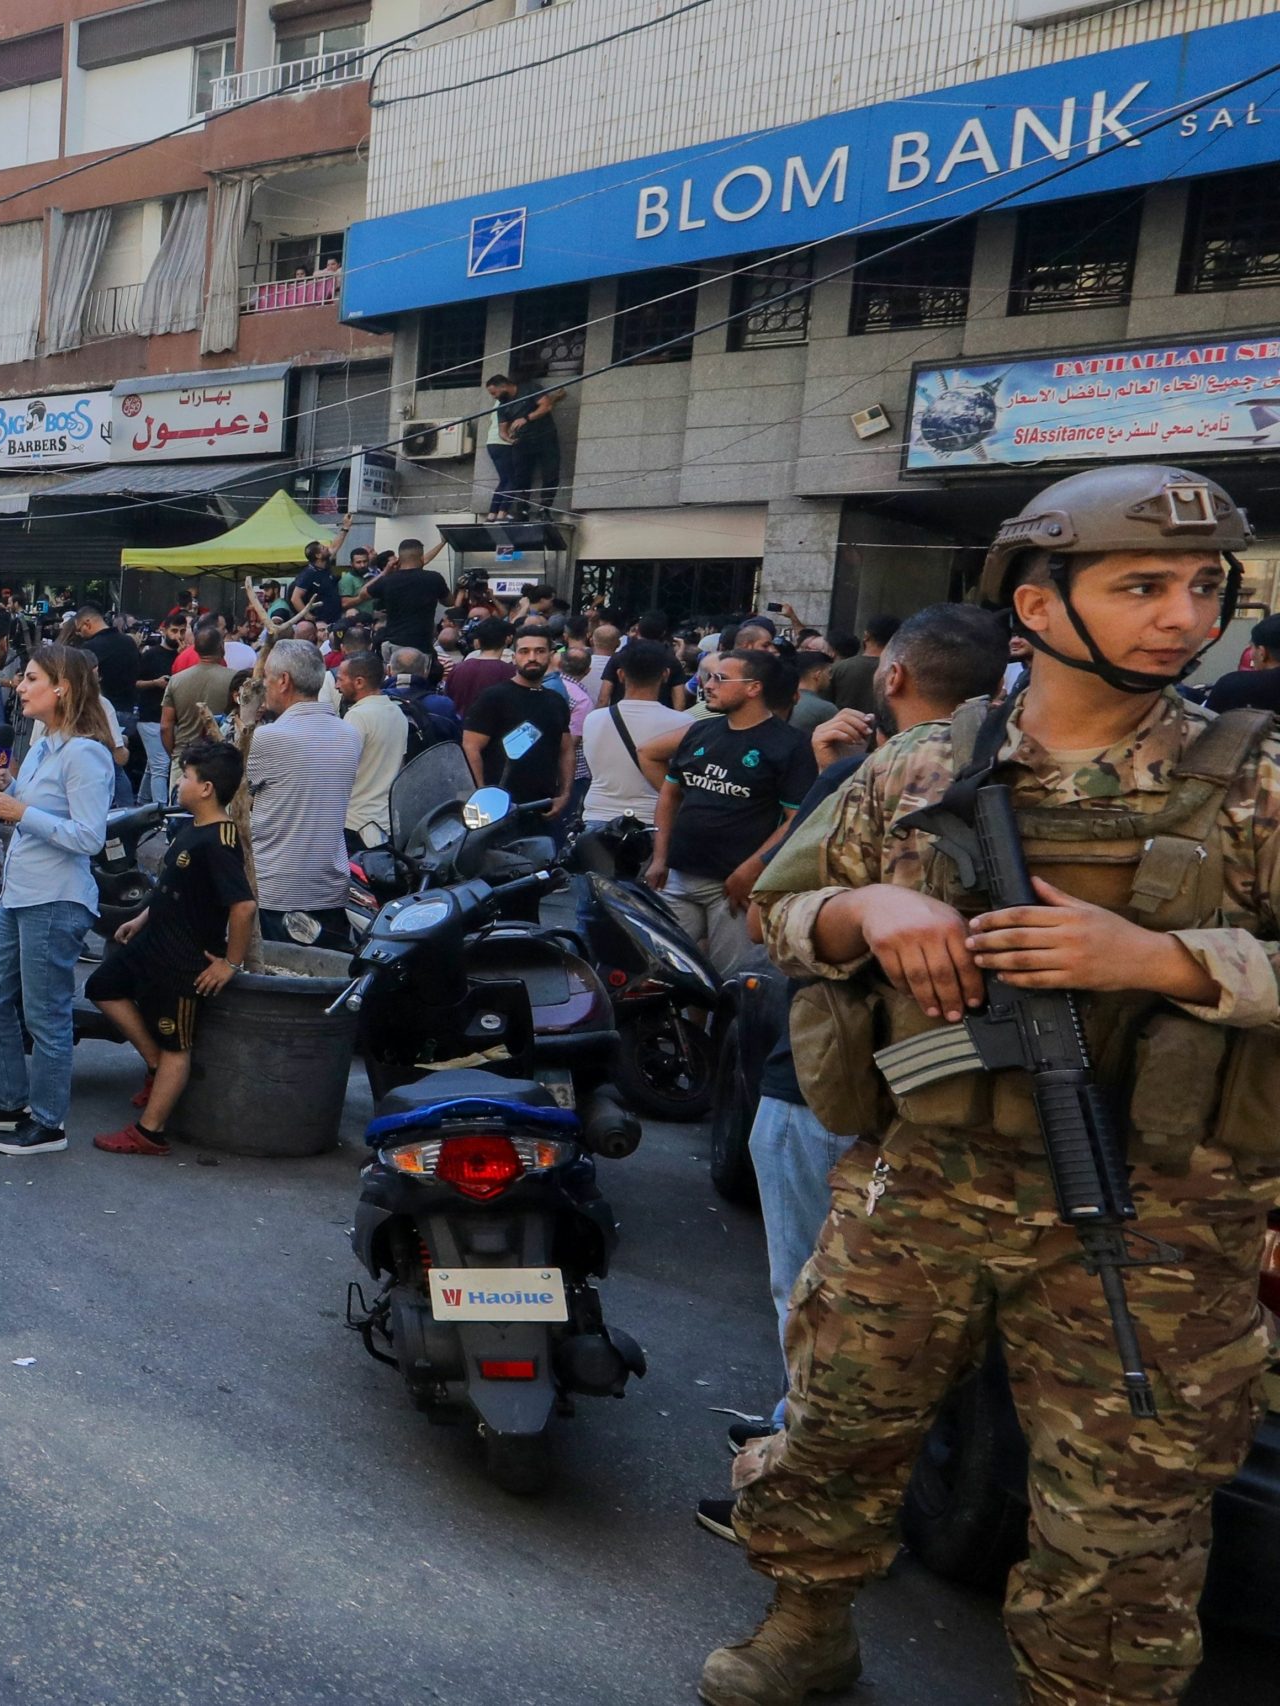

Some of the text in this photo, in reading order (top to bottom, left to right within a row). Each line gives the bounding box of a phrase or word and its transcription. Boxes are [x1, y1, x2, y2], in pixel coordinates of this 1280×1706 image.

[635, 81, 1261, 240] BLOM BANK SAL
[1054, 347, 1228, 377] FATHALLAH
[1115, 381, 1159, 400] العالم
[1205, 374, 1257, 395] جميع
[179, 389, 232, 407] بهارات
[132, 411, 270, 451] دعبول
[1107, 426, 1123, 444] مع
[1125, 420, 1158, 443] للسفر
[1161, 422, 1194, 443] صحي
[705, 764, 727, 779] Fly
[683, 772, 750, 798] Emirates
[468, 1291, 554, 1304] Haojue
